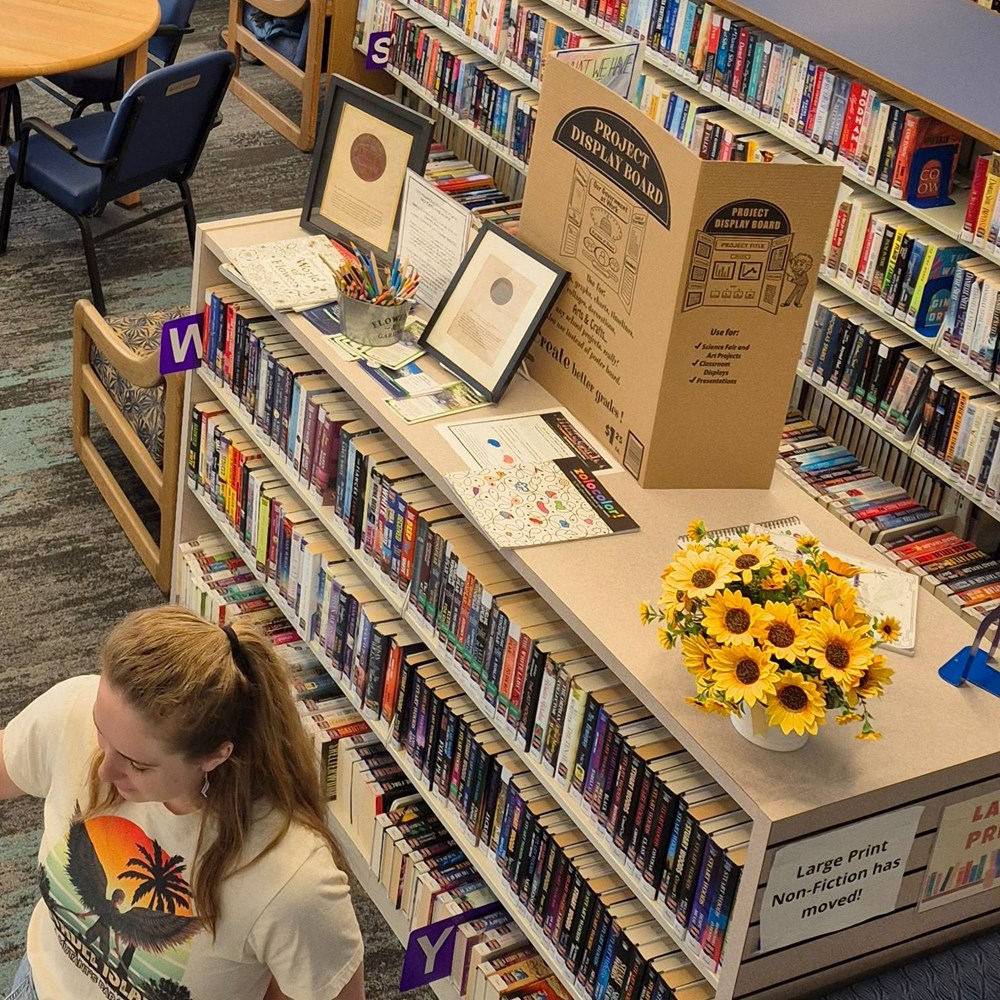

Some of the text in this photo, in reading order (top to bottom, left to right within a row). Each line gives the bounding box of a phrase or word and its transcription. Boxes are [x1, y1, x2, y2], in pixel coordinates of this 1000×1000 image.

[372, 38, 391, 64] S
[592, 53, 634, 77] WE HAVE
[851, 90, 867, 142] RODHAM
[570, 125, 663, 205] DISPLAY BOARD
[594, 118, 650, 169] PROJECT
[606, 199, 619, 214] Work
[715, 219, 781, 230] DISPLAY BOARD
[732, 207, 770, 217] PROJECT
[297, 258, 322, 283] World
[572, 304, 584, 320] Arts
[584, 314, 589, 326] &
[710, 328, 740, 337] Use for:
[537, 330, 570, 370] reate
[572, 362, 595, 392] better
[566, 315, 582, 332] school
[603, 348, 620, 367] really!
[566, 328, 585, 350] instead
[589, 353, 606, 370] poster
[572, 468, 626, 519] zolocolor!
[623, 767, 638, 814] STUART WOODS
[676, 824, 692, 874] STUART WOODS
[797, 840, 888, 880] Large Print
[699, 857, 714, 905] STUART WOODS
[715, 871, 729, 918] STUART WOODS
[772, 856, 901, 907] Non-Fiction has
[801, 888, 863, 919] moved!
[416, 925, 455, 974] Y
